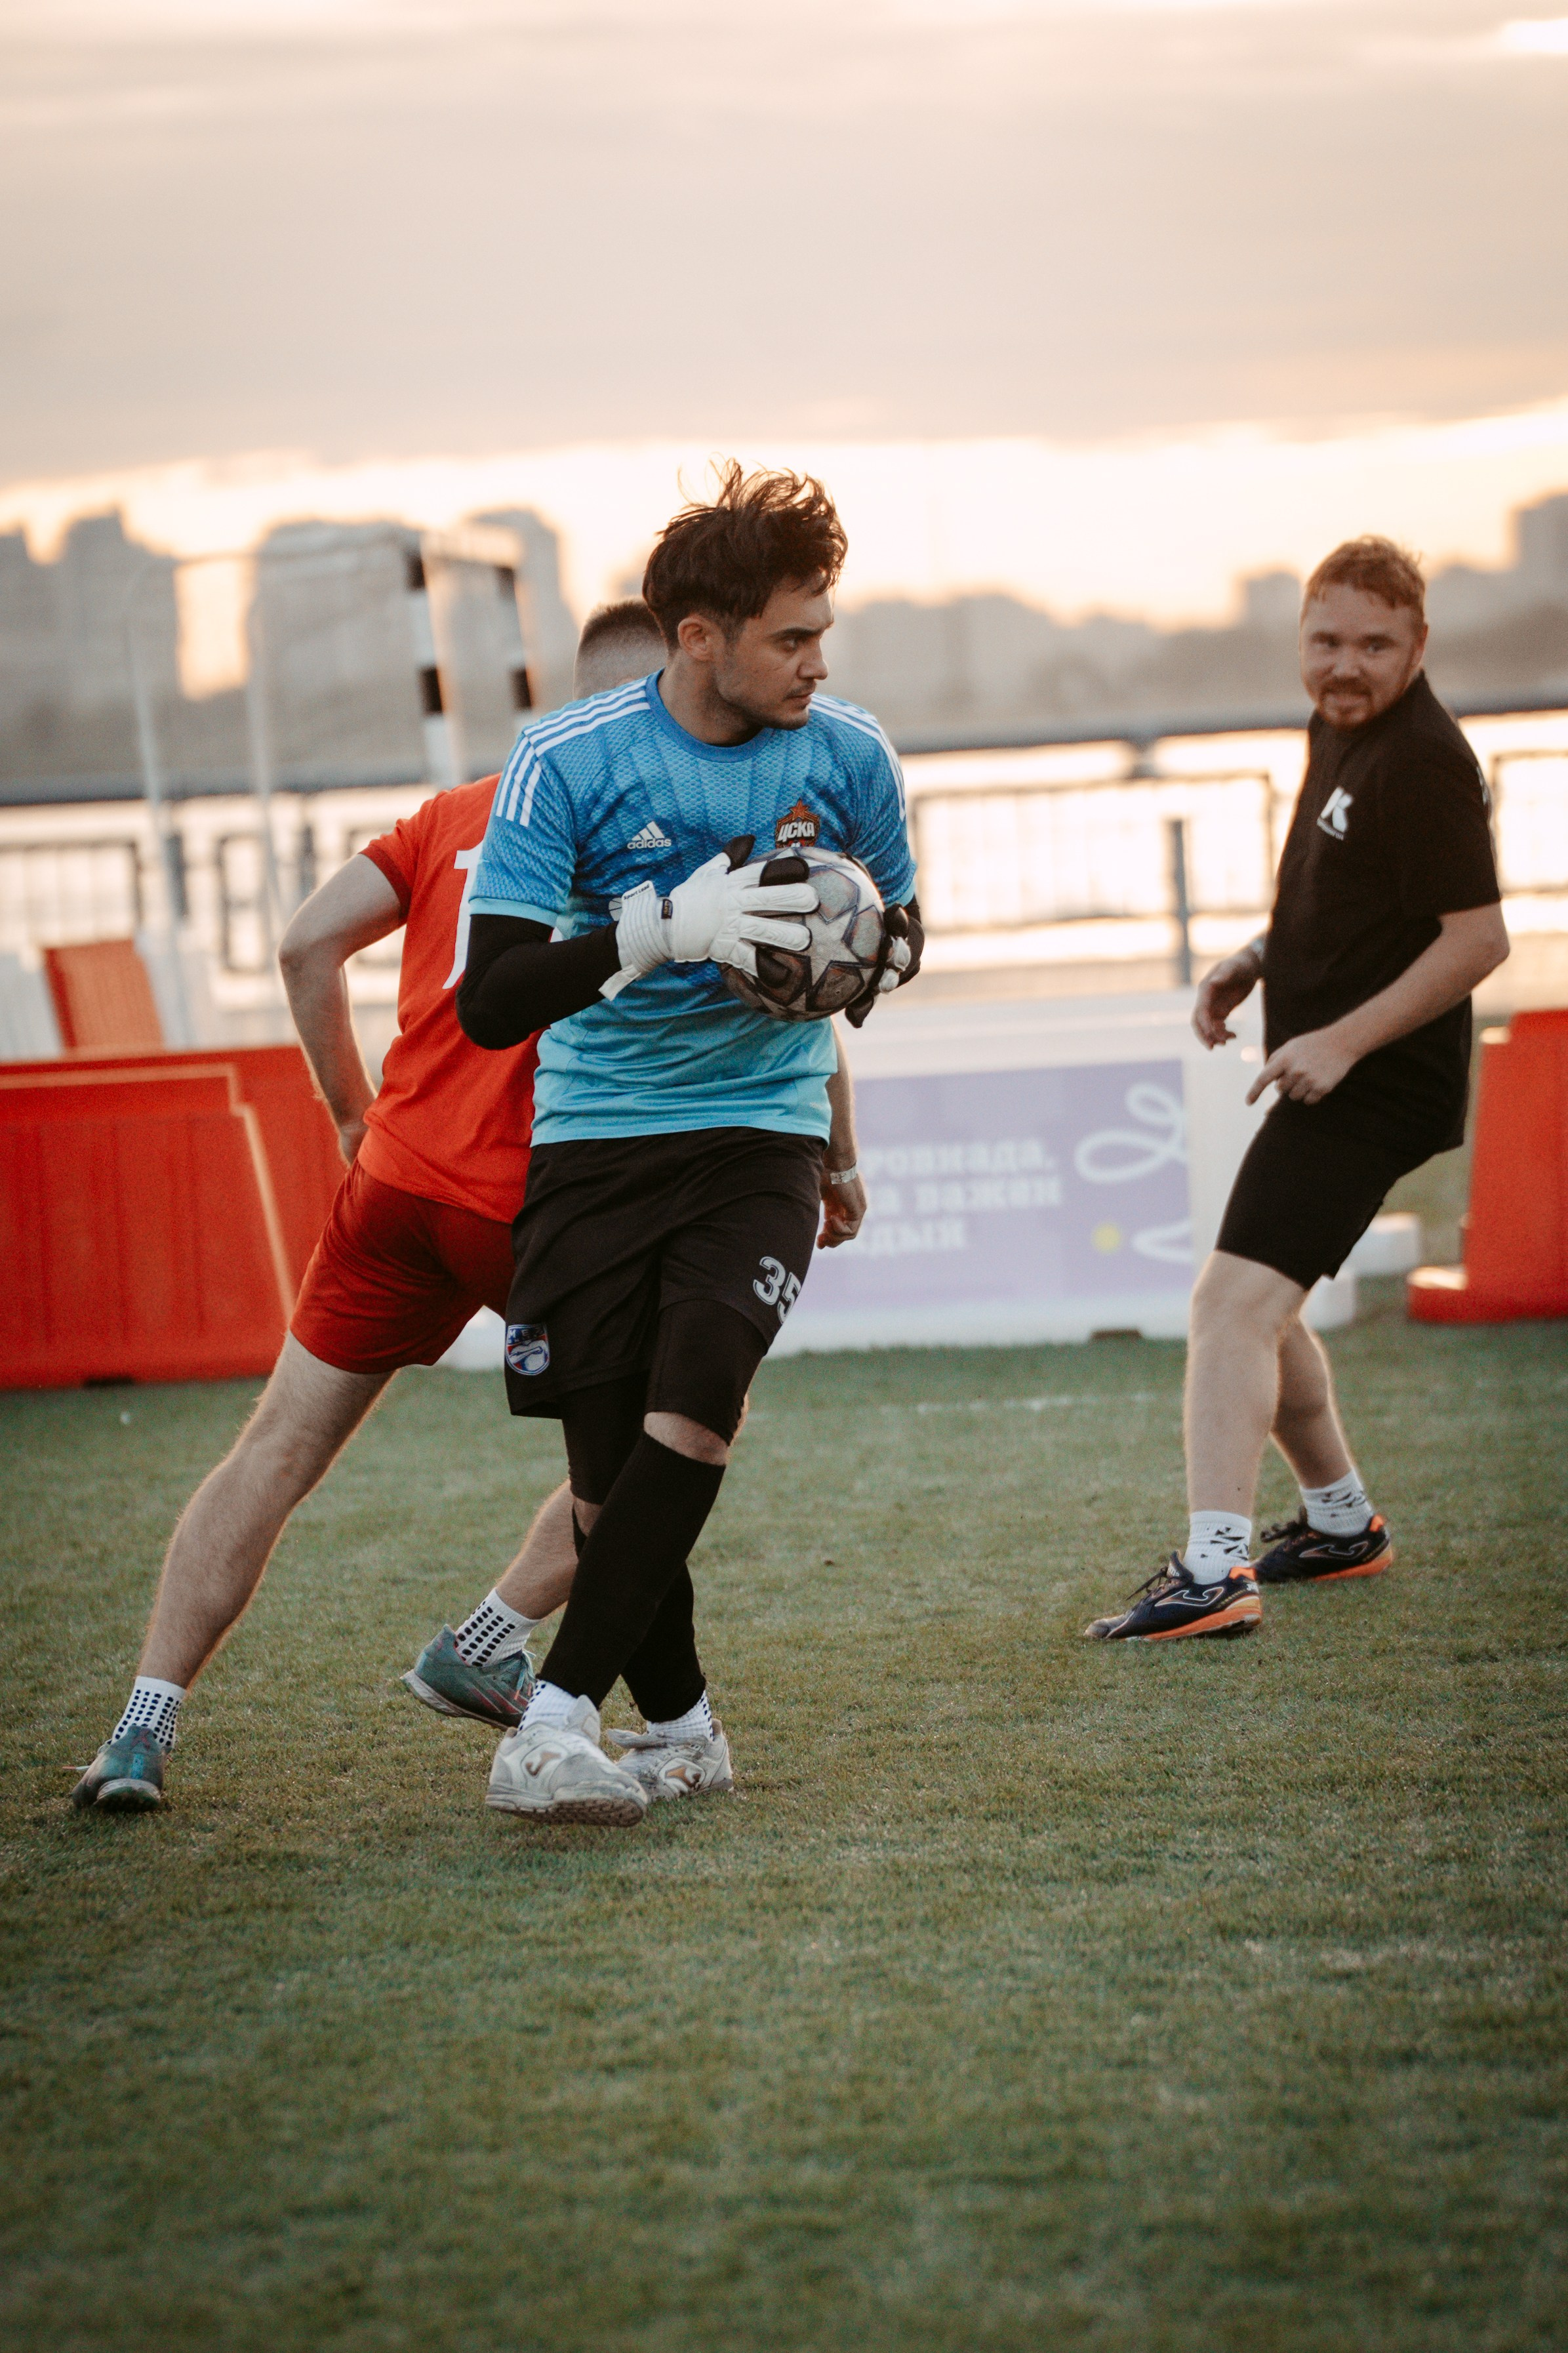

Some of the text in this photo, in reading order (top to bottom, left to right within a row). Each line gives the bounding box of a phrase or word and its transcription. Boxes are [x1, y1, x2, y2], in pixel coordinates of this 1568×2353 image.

[777, 821, 815, 842] ЦСКА
[627, 838, 672, 849] adidas
[753, 1256, 801, 1325] 35
